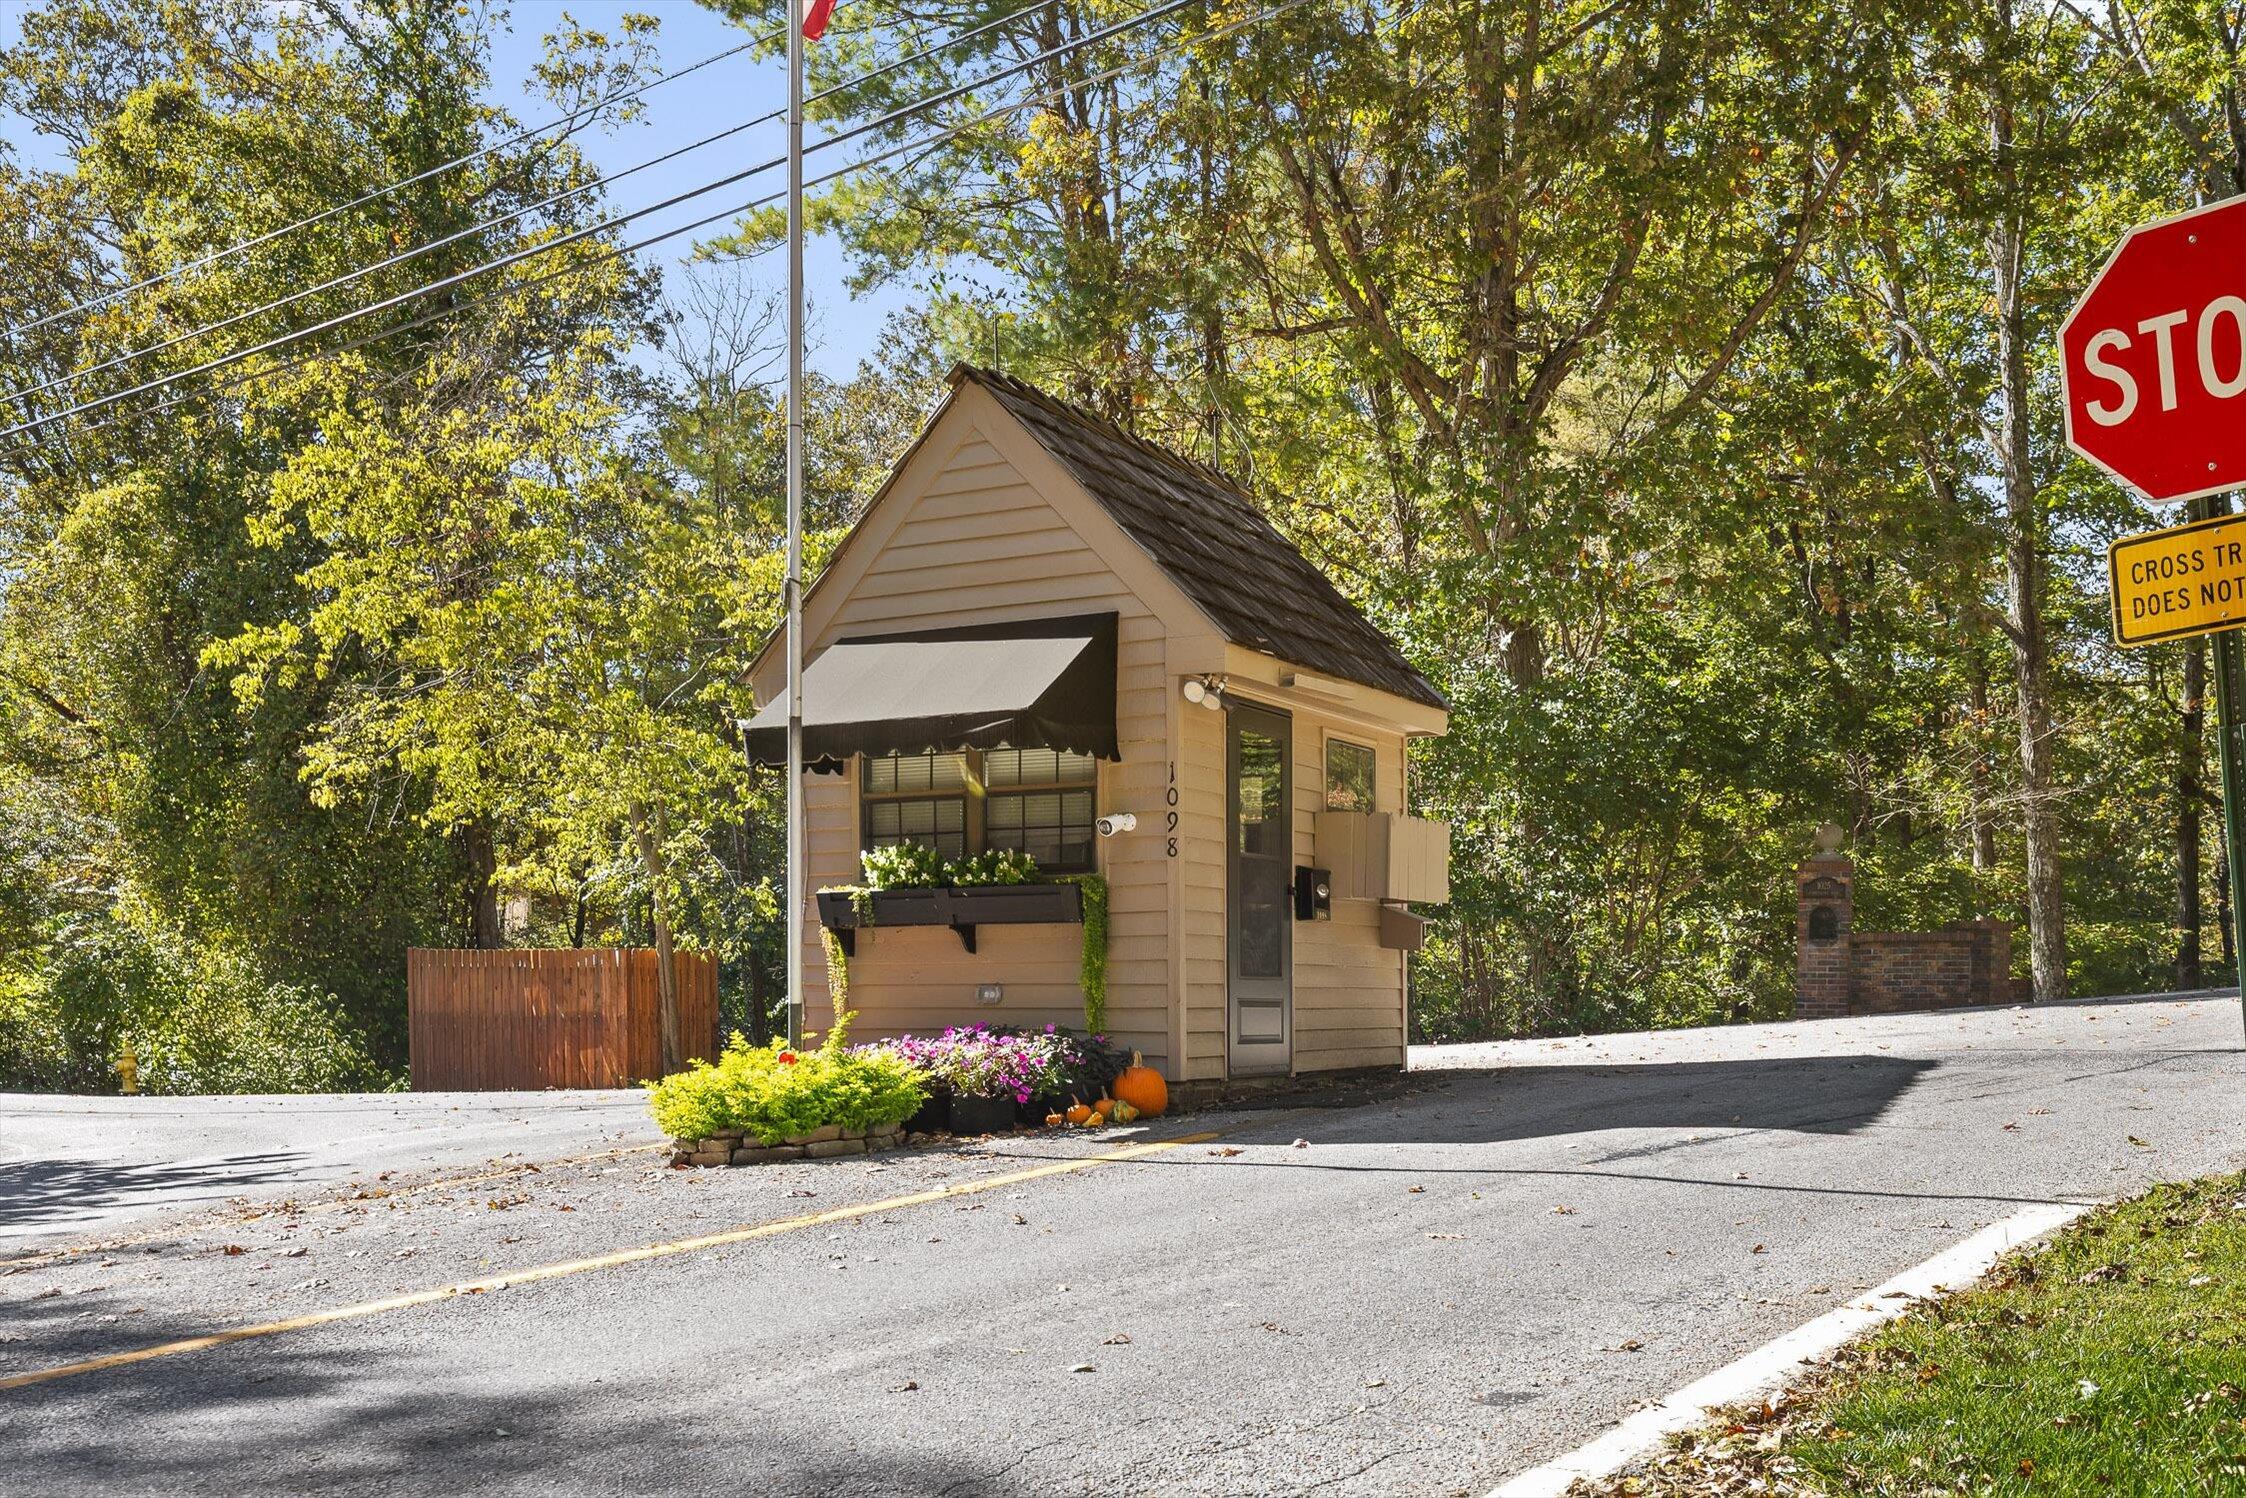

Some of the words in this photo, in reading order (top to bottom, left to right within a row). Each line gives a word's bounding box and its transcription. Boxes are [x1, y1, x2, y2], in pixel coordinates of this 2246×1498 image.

[2084, 295, 2246, 427] STO
[2131, 550, 2205, 585] CROSS
[2213, 542, 2243, 568] TR
[2132, 587, 2191, 619] DOES
[2200, 576, 2246, 606] NOT
[1167, 761, 1178, 857] 1098
